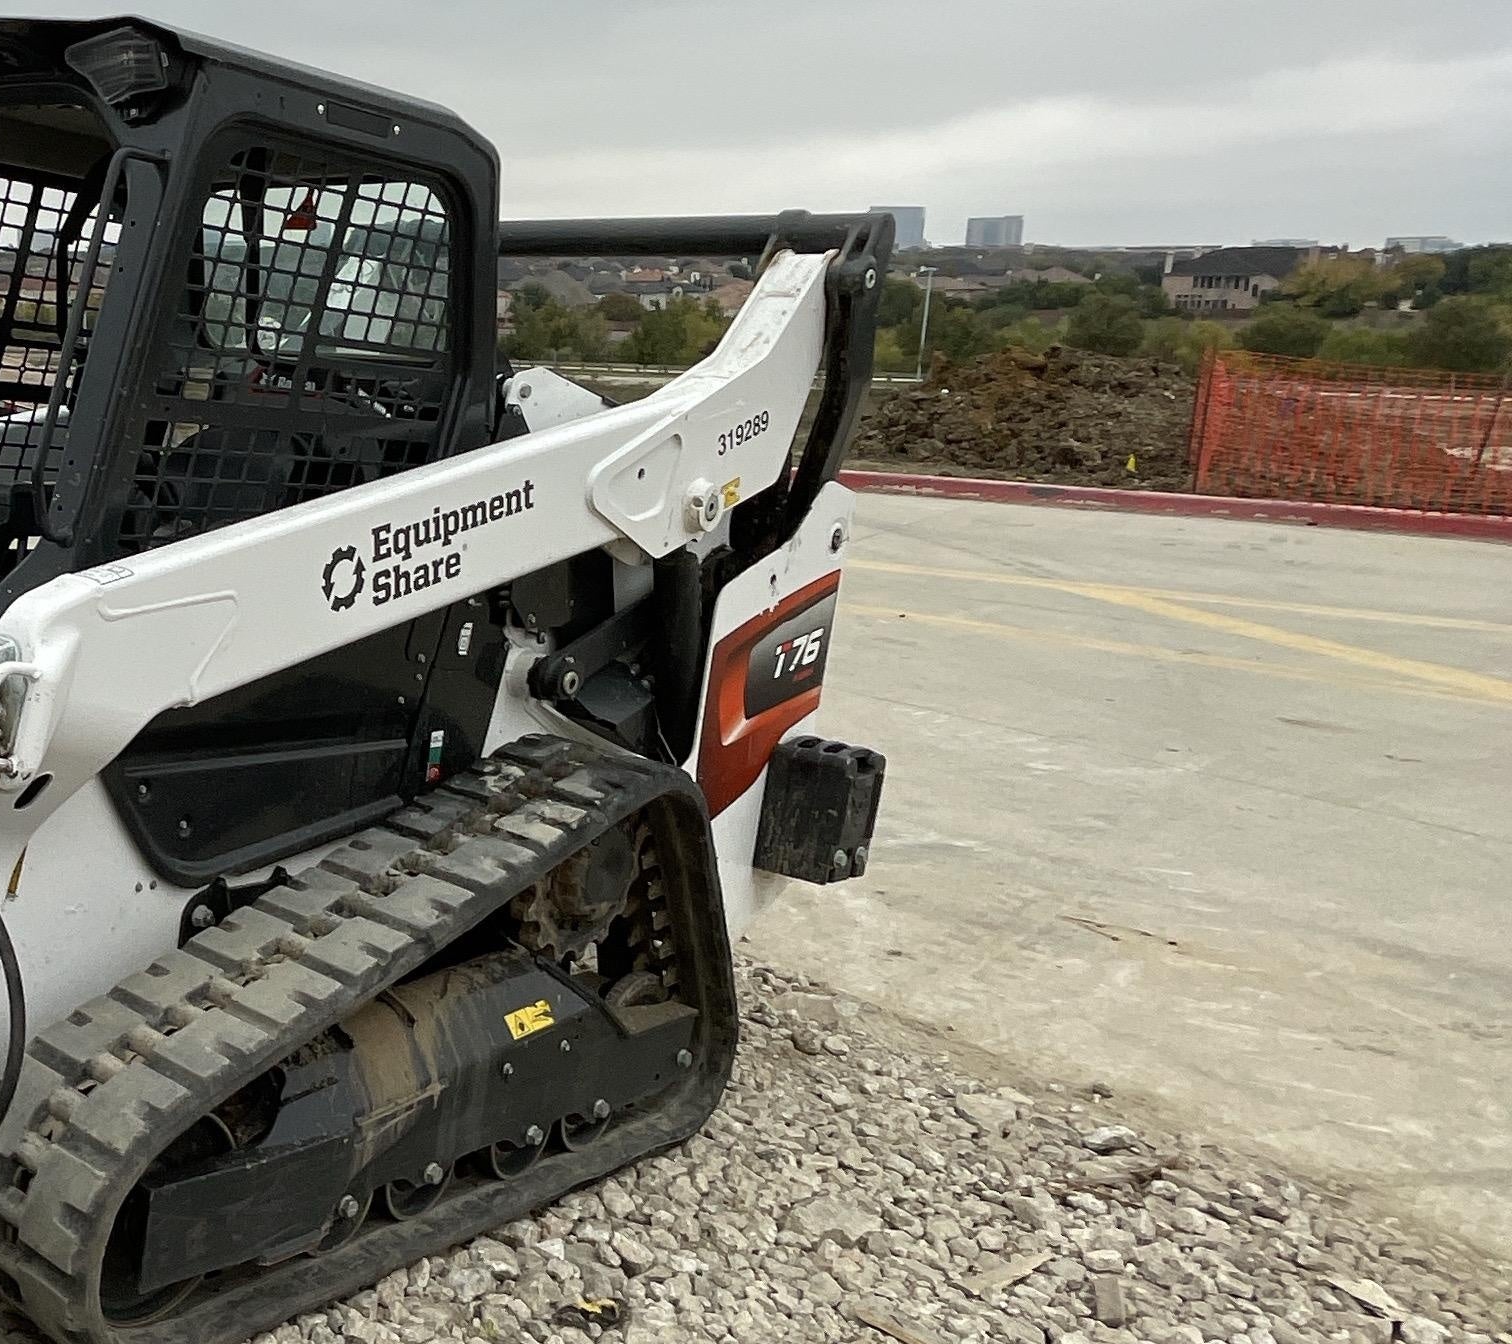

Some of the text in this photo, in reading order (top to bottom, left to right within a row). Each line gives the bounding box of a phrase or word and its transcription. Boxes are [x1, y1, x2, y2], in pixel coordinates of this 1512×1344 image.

[717, 410, 769, 456] 319289
[371, 480, 535, 563] Equipment
[372, 552, 462, 606] Share
